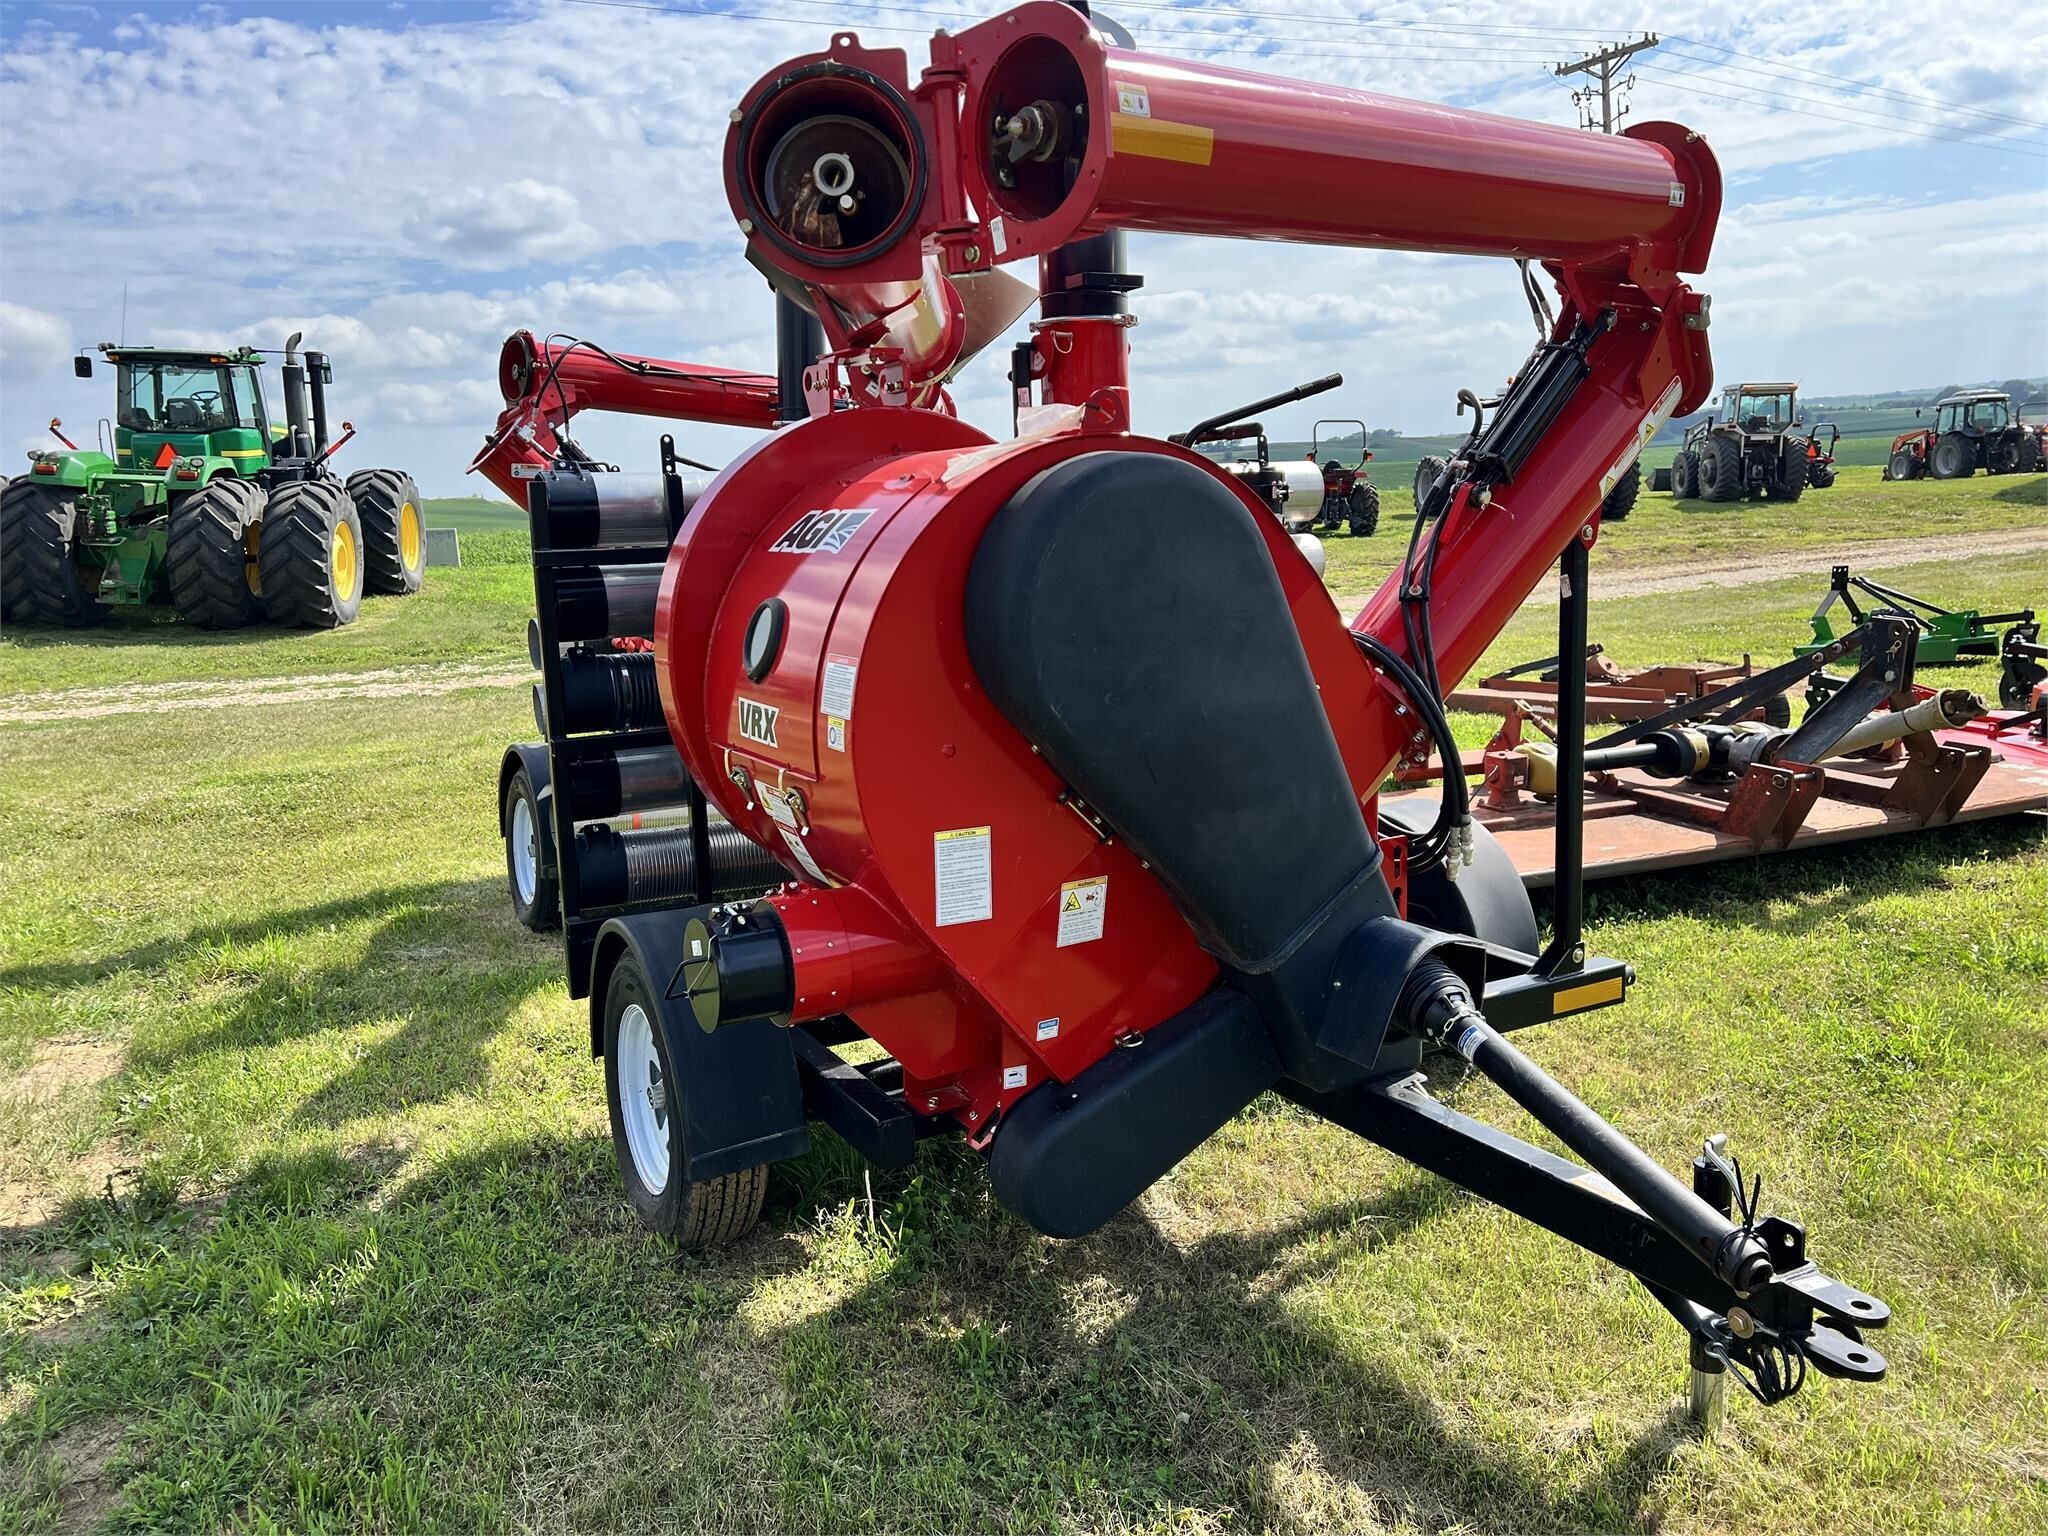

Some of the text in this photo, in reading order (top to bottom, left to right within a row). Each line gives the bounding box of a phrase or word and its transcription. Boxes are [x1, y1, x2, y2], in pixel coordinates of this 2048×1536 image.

[775, 513, 840, 550] AGI
[740, 701, 777, 744] VRX
[954, 830, 977, 838] CAUTION
